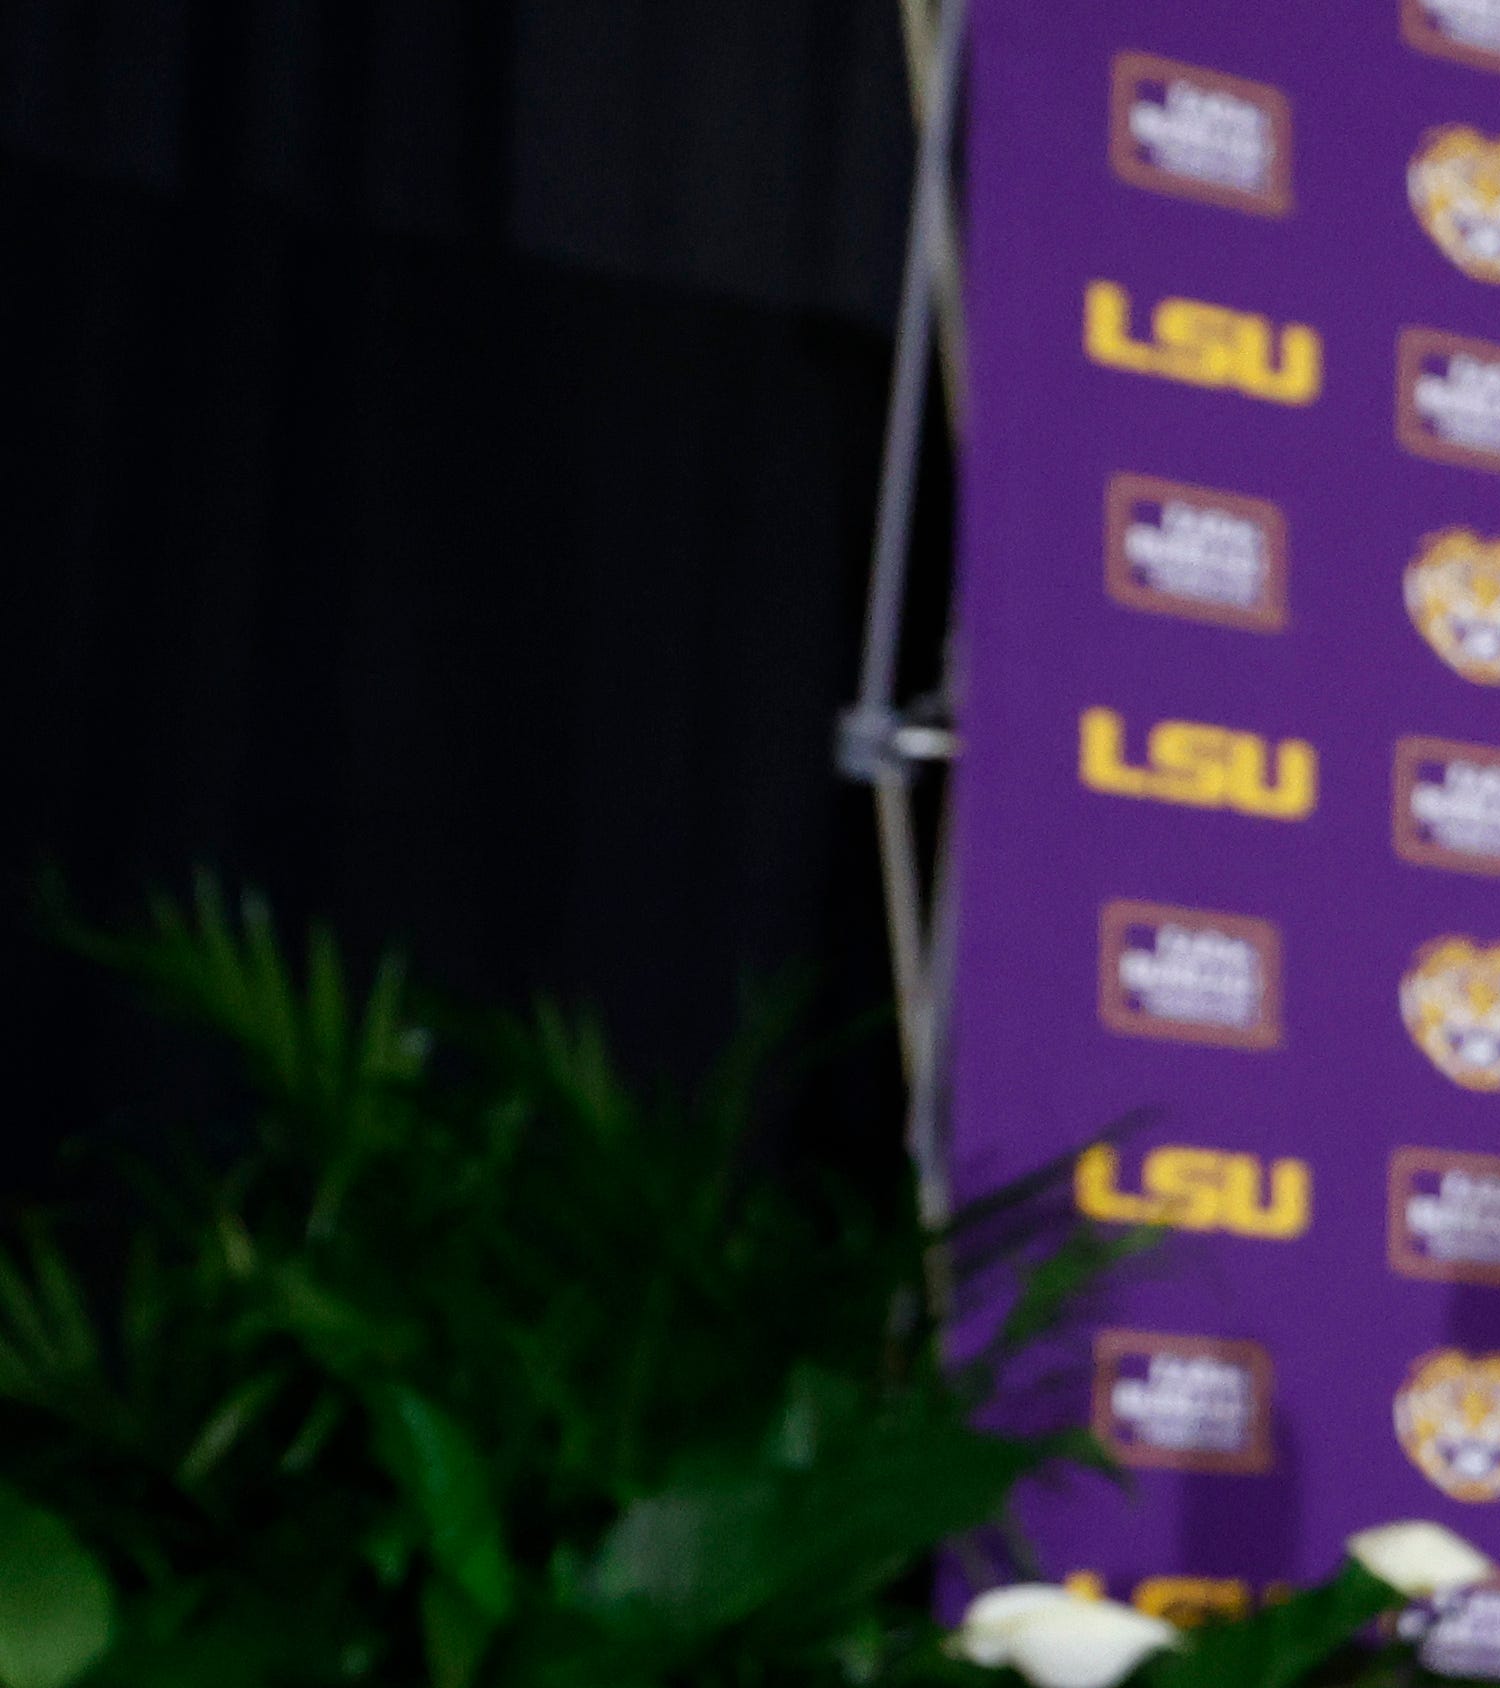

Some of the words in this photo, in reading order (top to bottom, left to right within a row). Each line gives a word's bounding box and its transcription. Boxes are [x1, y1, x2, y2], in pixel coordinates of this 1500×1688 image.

[1085, 281, 1320, 403] LSU
[1080, 708, 1315, 819] LSU
[1073, 1141, 1309, 1239] LSU
